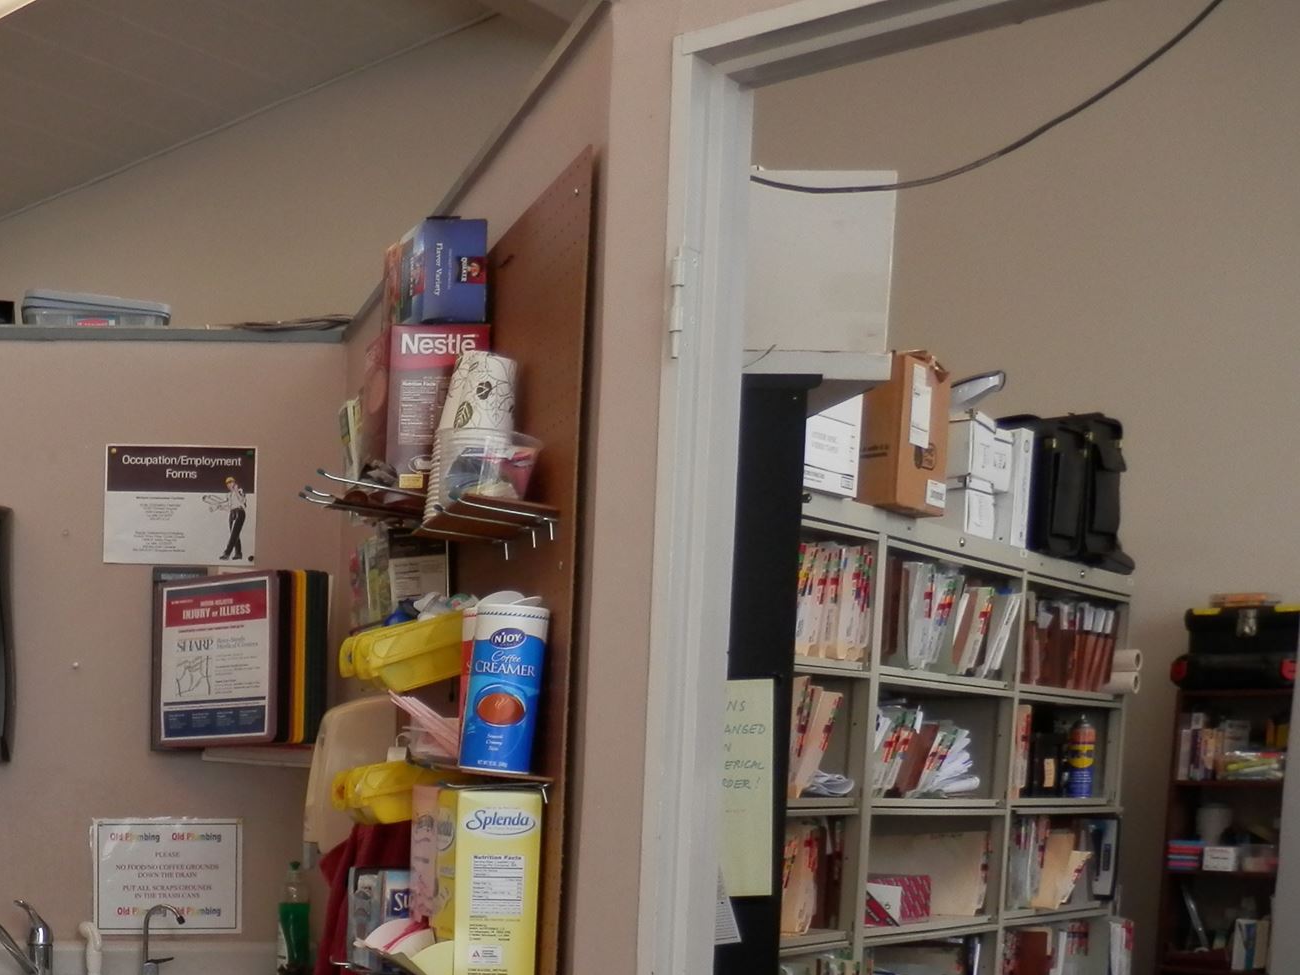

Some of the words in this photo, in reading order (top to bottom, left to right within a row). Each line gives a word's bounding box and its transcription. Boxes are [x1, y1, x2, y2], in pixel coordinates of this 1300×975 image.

[436, 242, 444, 267] Flavor
[434, 268, 444, 296] Variety
[122, 454, 242, 468] Occupation/Employment
[165, 468, 198, 479] Forms
[182, 607, 211, 620] INJURY
[219, 603, 251, 617] ILLNESS
[491, 650, 521, 663] Coffee
[475, 660, 536, 677] CREAMER
[724, 723, 766, 735] ANGED
[724, 759, 765, 770] ERICAL
[466, 809, 530, 830] Splenda
[172, 832, 185, 841] Old
[117, 907, 130, 916] Old
